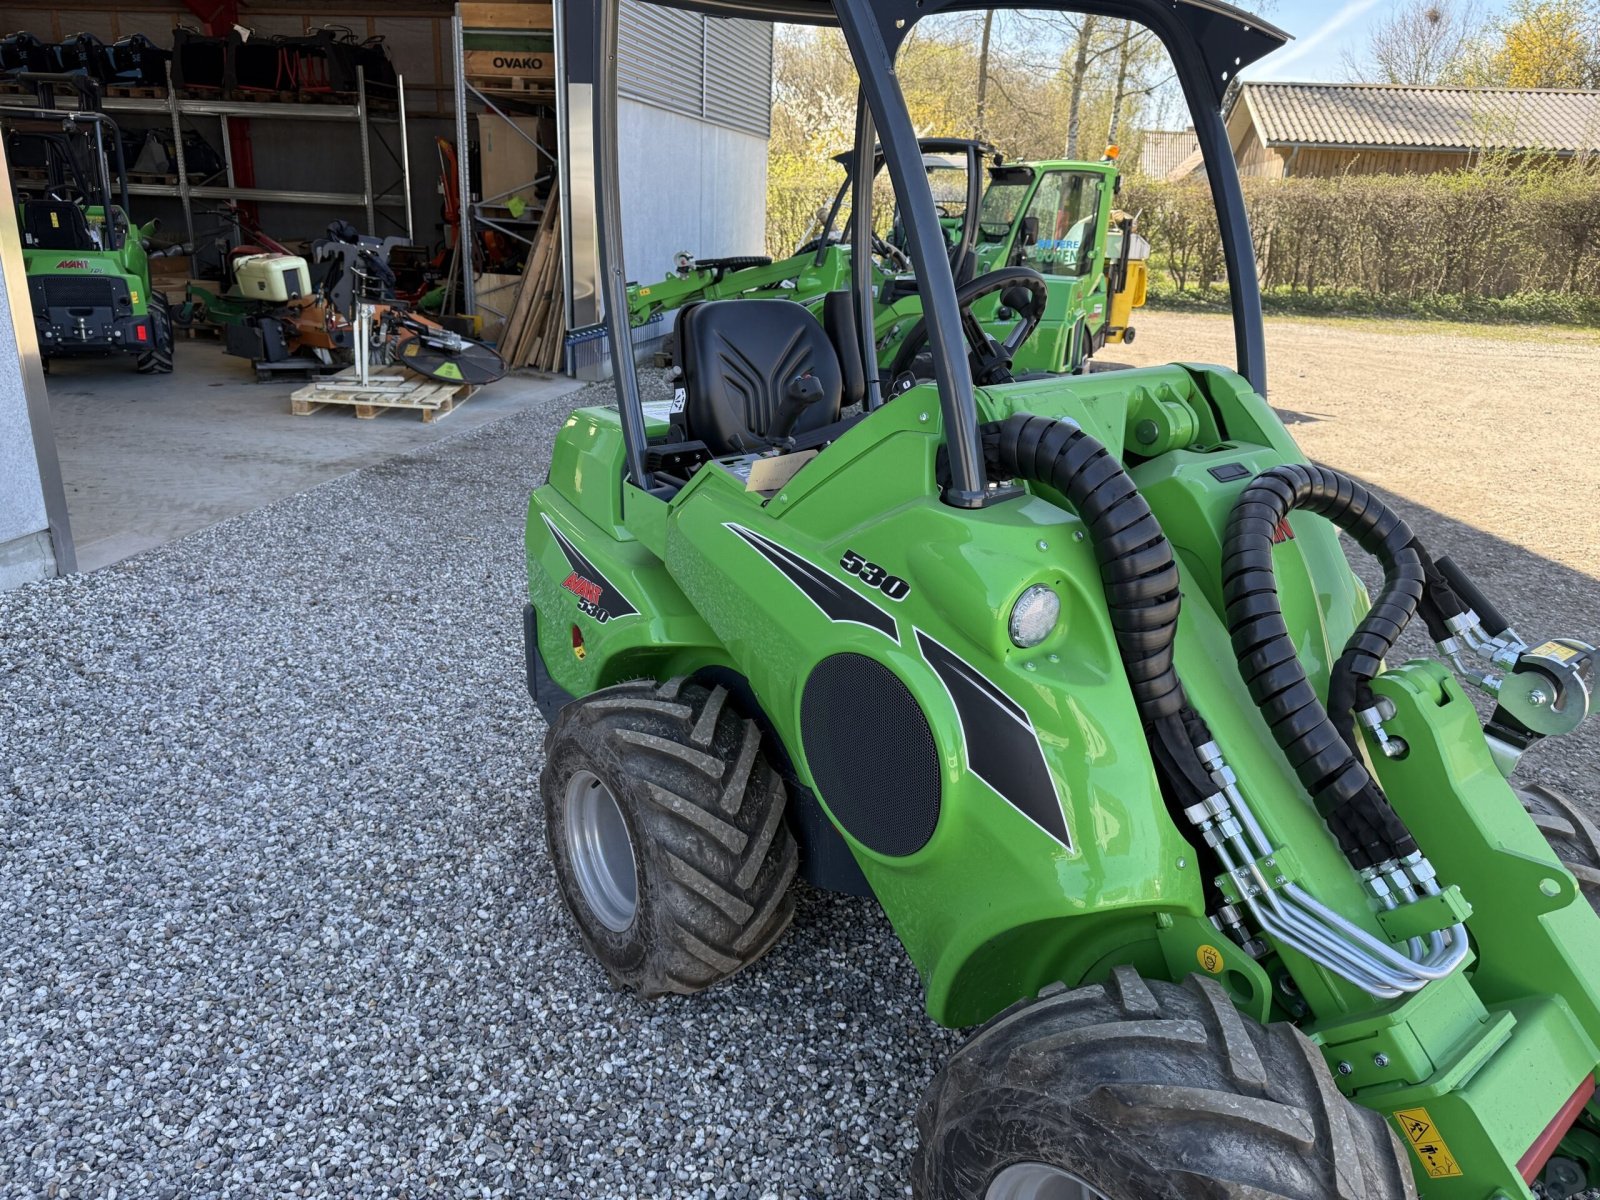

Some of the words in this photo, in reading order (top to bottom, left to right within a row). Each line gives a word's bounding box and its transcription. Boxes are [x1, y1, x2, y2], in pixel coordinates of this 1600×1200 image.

[492, 56, 543, 70] OVAKO
[56, 259, 89, 269] AVANT
[560, 570, 604, 606] AVANT
[839, 548, 911, 602] 530
[577, 597, 611, 624] 530
